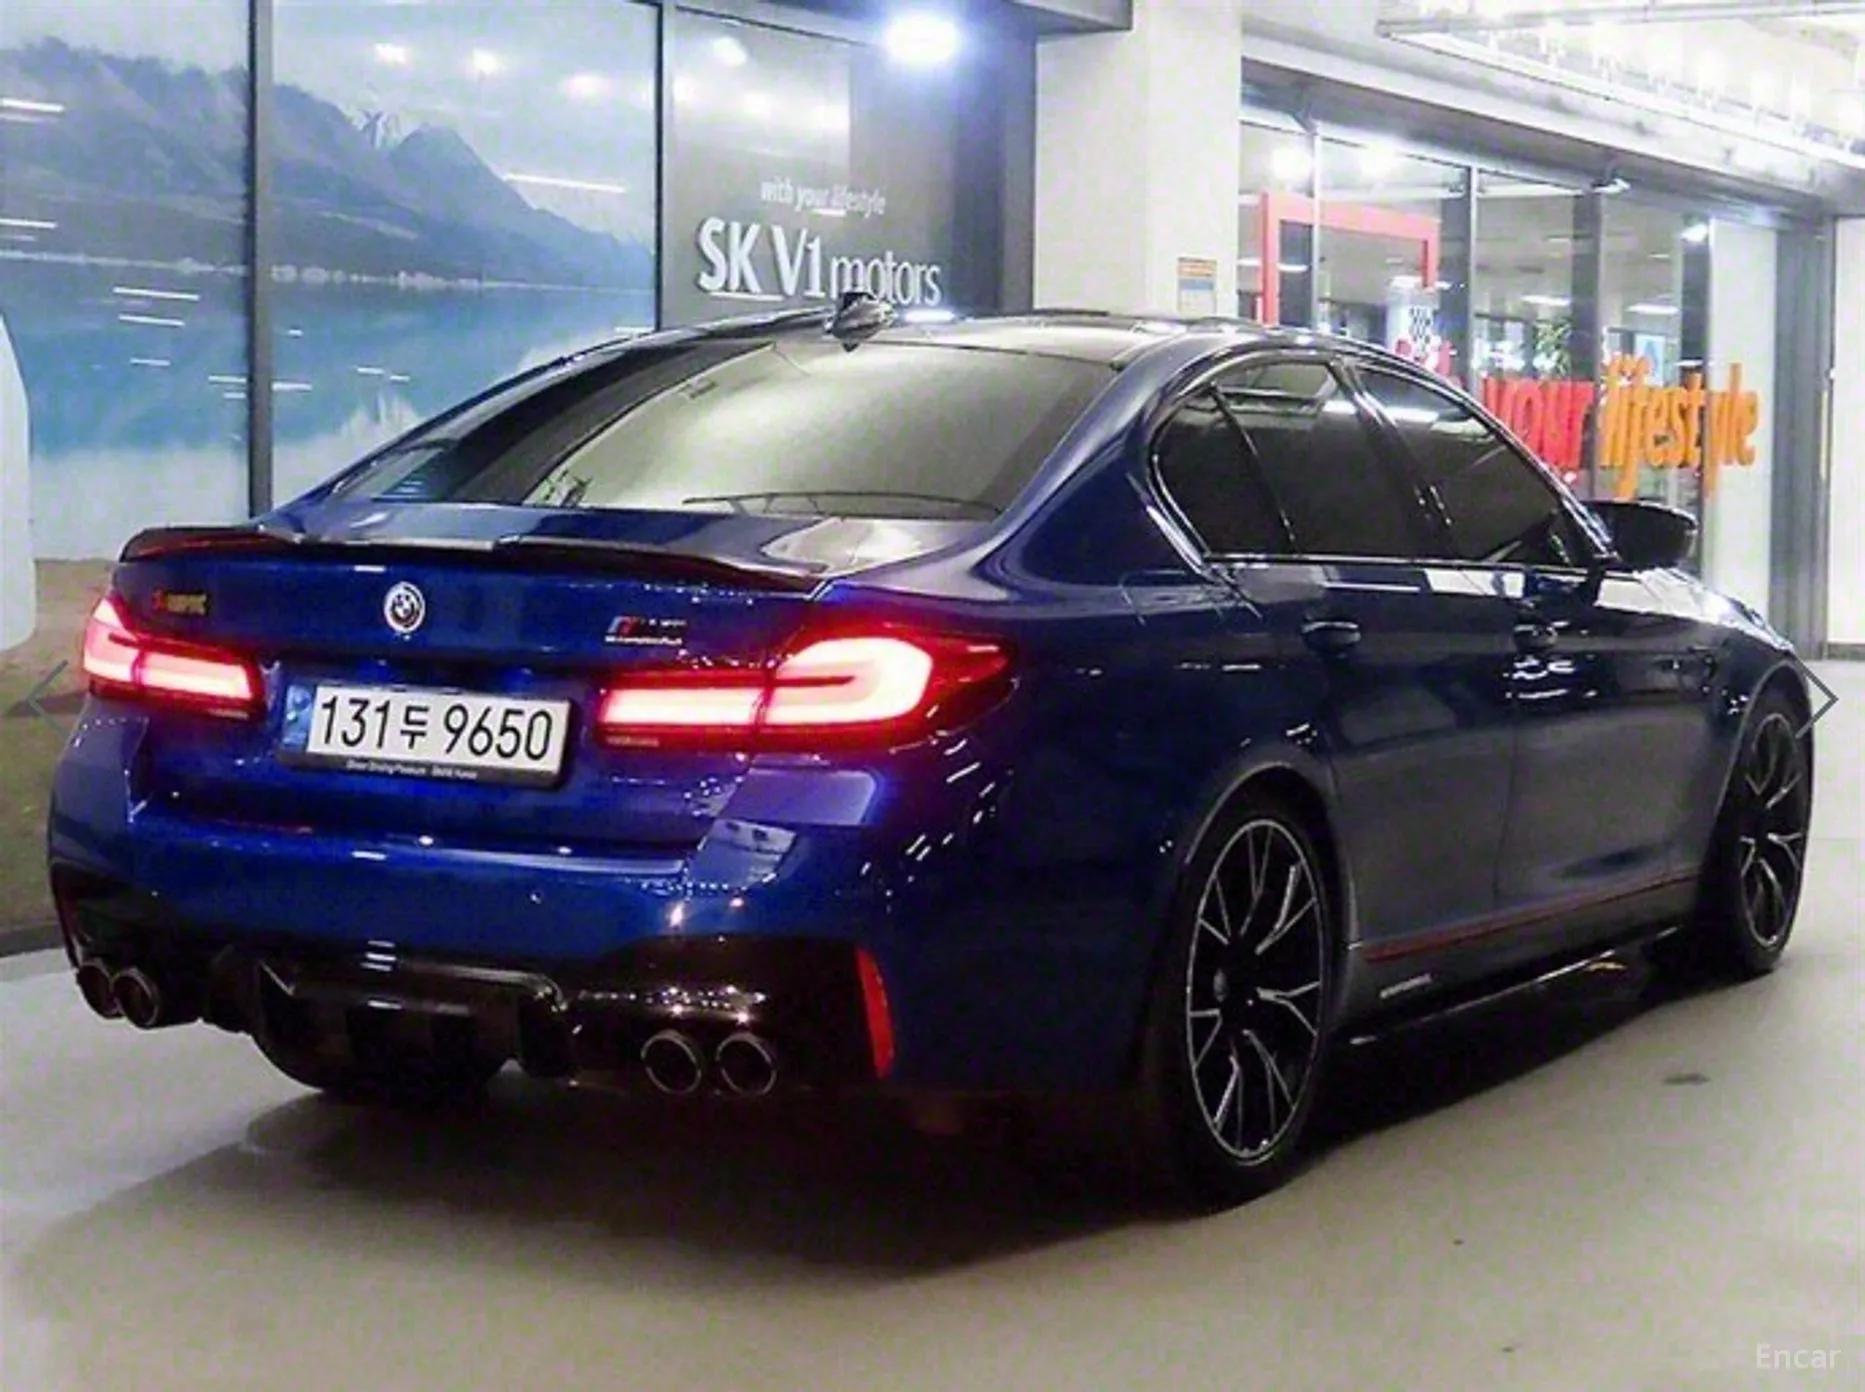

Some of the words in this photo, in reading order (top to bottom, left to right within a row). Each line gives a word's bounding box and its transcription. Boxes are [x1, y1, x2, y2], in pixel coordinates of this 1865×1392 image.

[761, 176, 794, 203] with
[795, 186, 829, 212] your
[698, 216, 763, 294] SK
[770, 225, 825, 296] V1
[830, 250, 941, 305] motors
[1599, 353, 1759, 502] lifestyle
[321, 695, 430, 750] 131두
[443, 703, 553, 761] 9650
